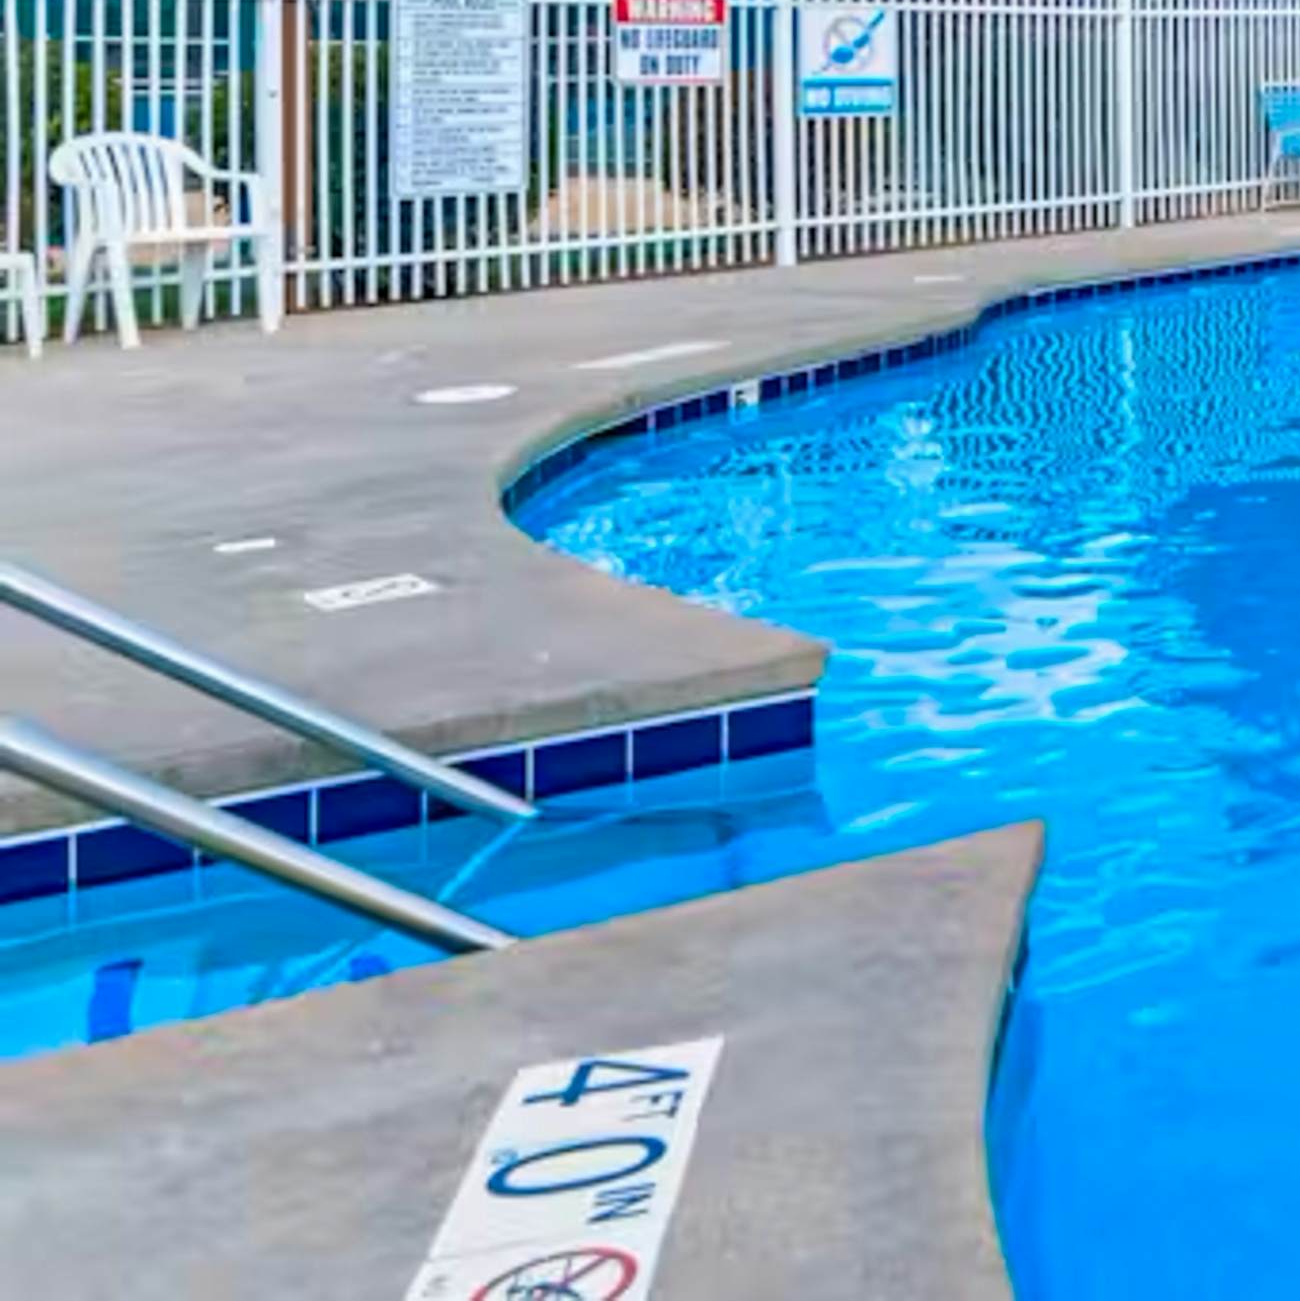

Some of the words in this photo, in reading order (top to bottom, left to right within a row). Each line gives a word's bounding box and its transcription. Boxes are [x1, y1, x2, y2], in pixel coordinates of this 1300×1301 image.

[621, 29, 640, 50] NO
[646, 29, 717, 49] LIFEGUARD
[641, 55, 659, 75] ON
[666, 55, 699, 75] DUTY
[806, 87, 830, 108] NO
[521, 1057, 690, 1108] 4
[622, 1089, 685, 1123] FT
[486, 1135, 667, 1197] 0
